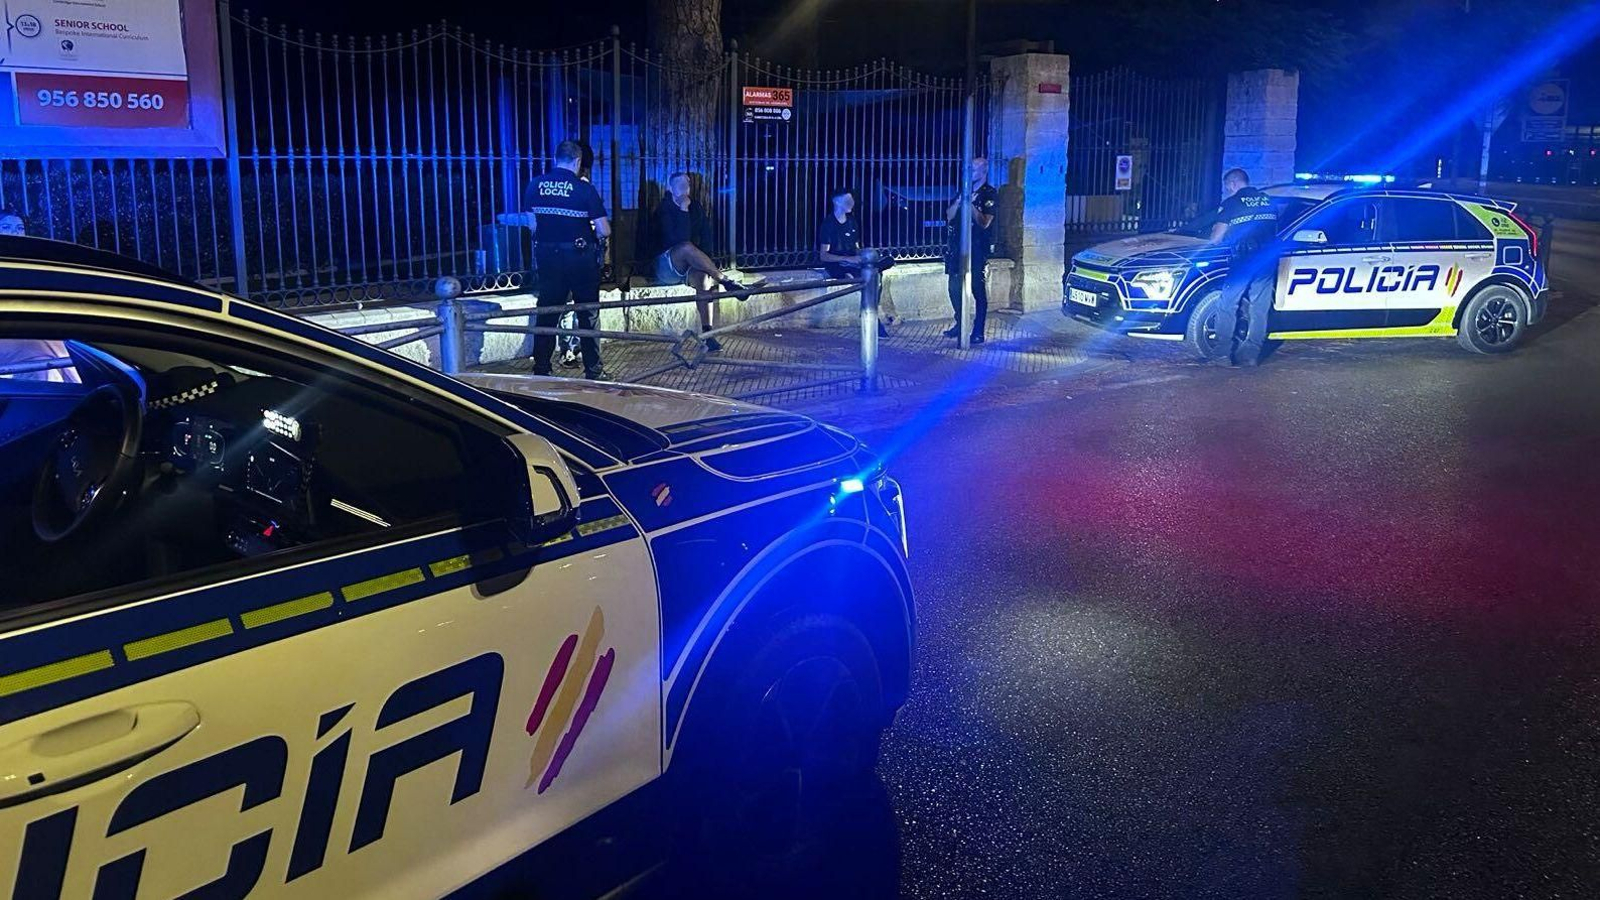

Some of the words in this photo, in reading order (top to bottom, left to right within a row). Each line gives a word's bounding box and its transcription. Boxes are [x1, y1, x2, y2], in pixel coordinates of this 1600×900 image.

[54, 19, 90, 29] SENIOR
[92, 22, 130, 32] SCHOOL
[55, 28, 80, 37] Bespoke
[81, 30, 118, 39] International
[118, 33, 150, 41] Curriculum
[37, 89, 79, 108] 956
[83, 91, 123, 109] 850
[127, 93, 164, 110] 560
[745, 90, 772, 98] ALARMAS
[772, 90, 790, 101] 365
[538, 180, 574, 191] POLICÍA
[539, 188, 570, 197] LOCAL
[1287, 264, 1441, 296] POLICÍA
